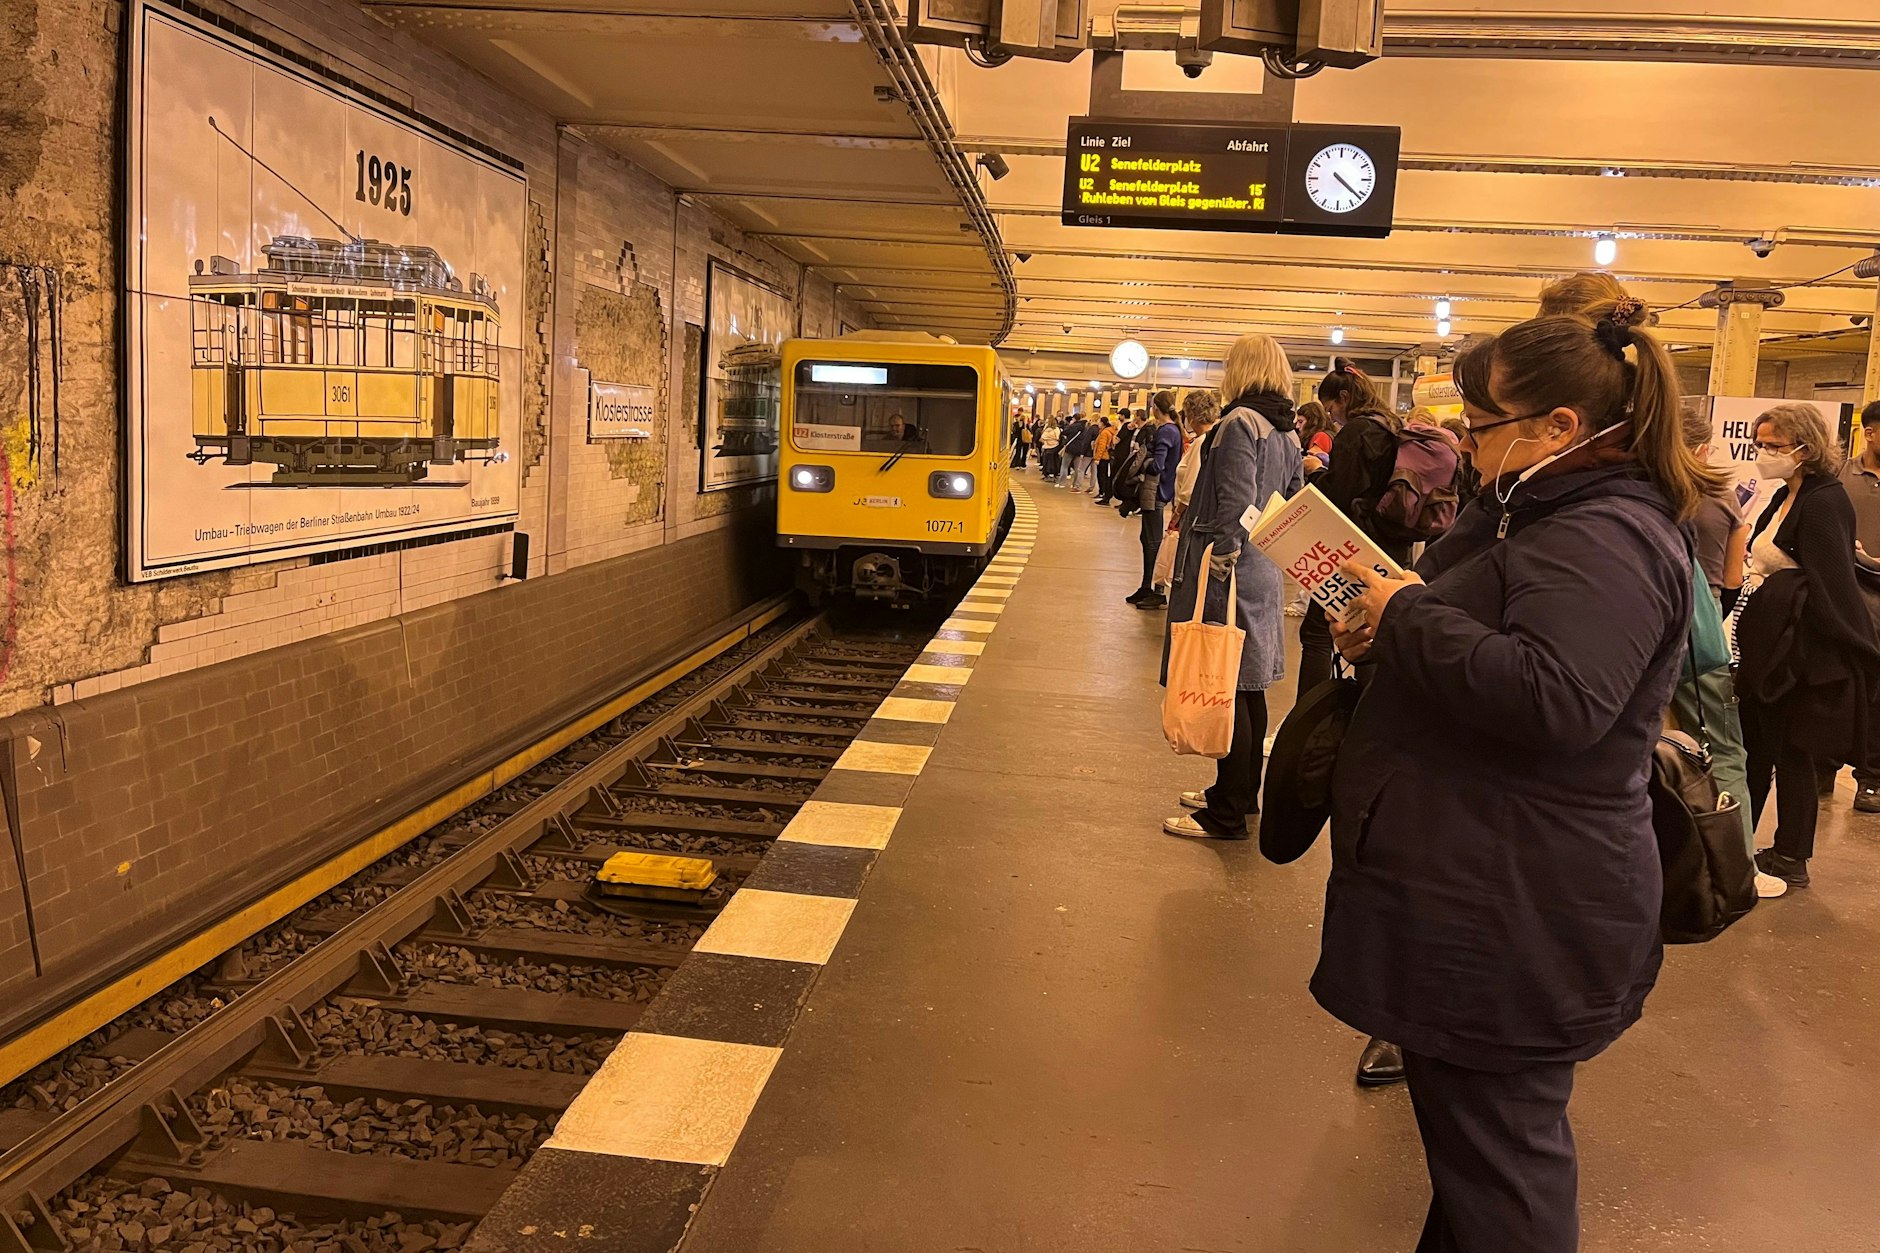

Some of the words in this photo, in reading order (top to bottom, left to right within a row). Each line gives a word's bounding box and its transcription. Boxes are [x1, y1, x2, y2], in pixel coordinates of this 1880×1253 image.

[1081, 136, 1105, 147] Linie
[1112, 136, 1131, 147] Ziel
[1227, 140, 1269, 152] Abfahrt
[1081, 153, 1101, 172] U2
[1111, 157, 1202, 174] Senefelderplatz
[356, 149, 412, 216] 1925
[1079, 177, 1095, 190] U2
[1109, 178, 1200, 195] Senefelderplatz
[1082, 191, 1133, 205] Ruhleben
[1159, 194, 1186, 207] Gleis
[1078, 214, 1103, 224] Gleis
[1106, 215, 1111, 225] 1
[332, 385, 351, 403] 3061
[596, 395, 653, 422] Klosterstrasse
[810, 431, 855, 440] Klosterstraße
[1722, 420, 1754, 439] HEU
[471, 498, 490, 509] Baujahr
[286, 519, 298, 531] der
[300, 516, 330, 529] Berliner
[331, 509, 373, 525] Straßenbahn
[375, 508, 397, 520] Umbau
[926, 520, 963, 533] 1077-1
[1257, 537, 1271, 548] THE
[1270, 504, 1309, 538] MINIMALISTS
[1299, 540, 1360, 591] PEOPLE
[1313, 572, 1348, 602] USE
[1325, 563, 1389, 613] THINS
